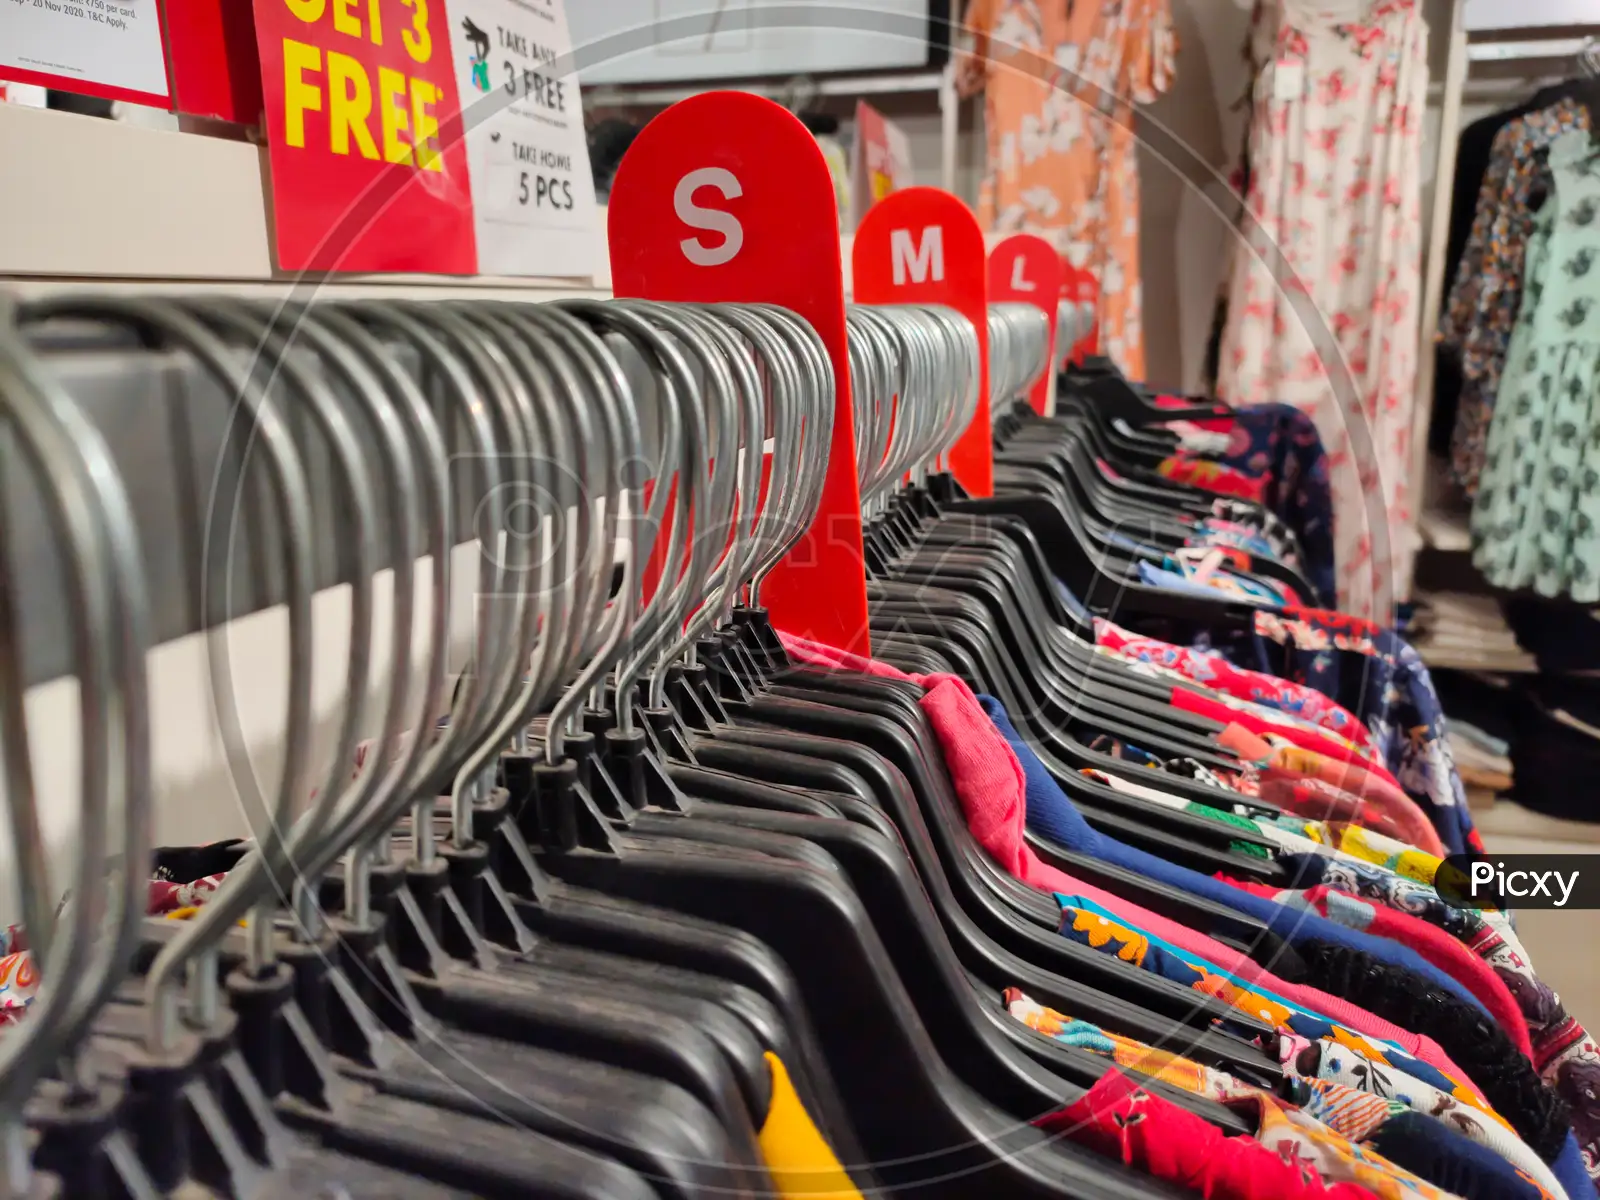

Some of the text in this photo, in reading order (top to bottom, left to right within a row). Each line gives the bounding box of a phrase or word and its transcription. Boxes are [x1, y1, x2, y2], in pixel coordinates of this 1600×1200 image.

[45, 0, 61, 12] Nov
[88, 10, 104, 23] T&C
[106, 4, 118, 13] per
[497, 25, 527, 58] TAKE
[504, 60, 566, 113] 3 FREE
[512, 141, 571, 172] TAKE HOME
[519, 171, 574, 211] 5 PCS
[673, 166, 744, 266] S
[890, 225, 945, 285] M
[1011, 255, 1036, 292] L
